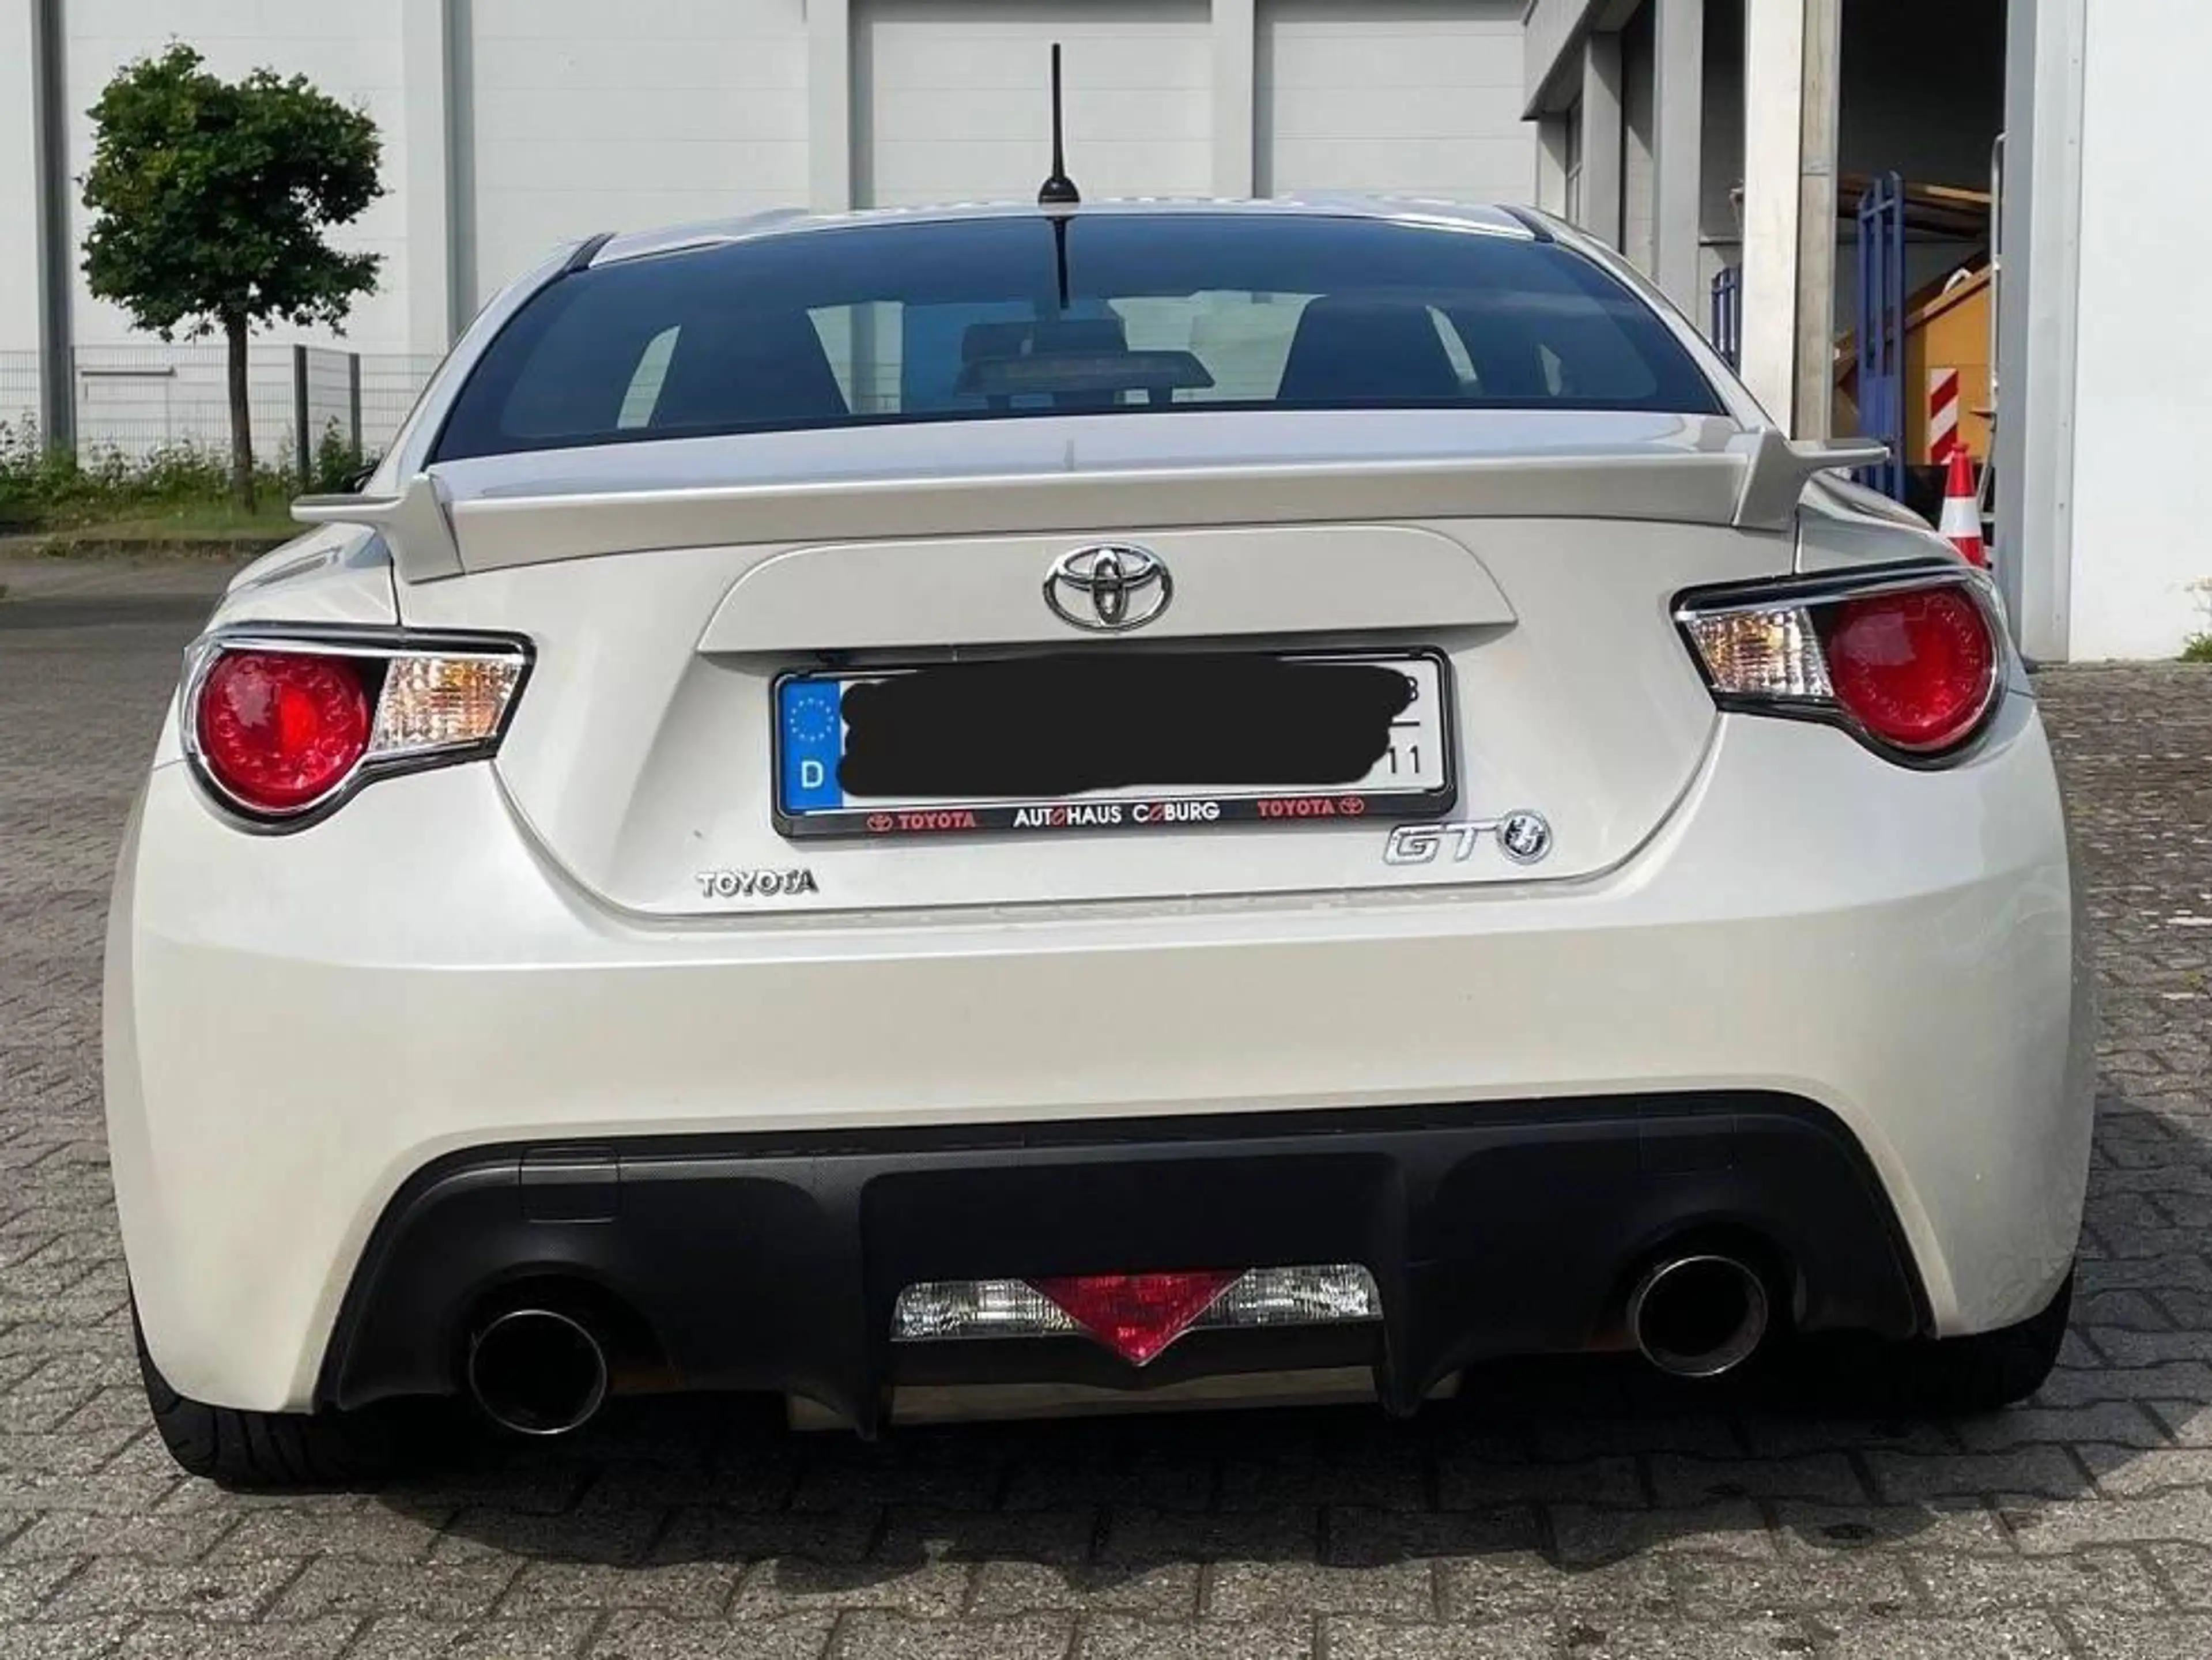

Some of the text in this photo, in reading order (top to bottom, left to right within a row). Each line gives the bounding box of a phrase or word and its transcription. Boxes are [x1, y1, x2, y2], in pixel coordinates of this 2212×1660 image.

[802, 761, 823, 788] D
[897, 810, 976, 830] TOYOTA
[1257, 799, 1336, 817] TOYOTA
[697, 867, 820, 897] TOYOTA
